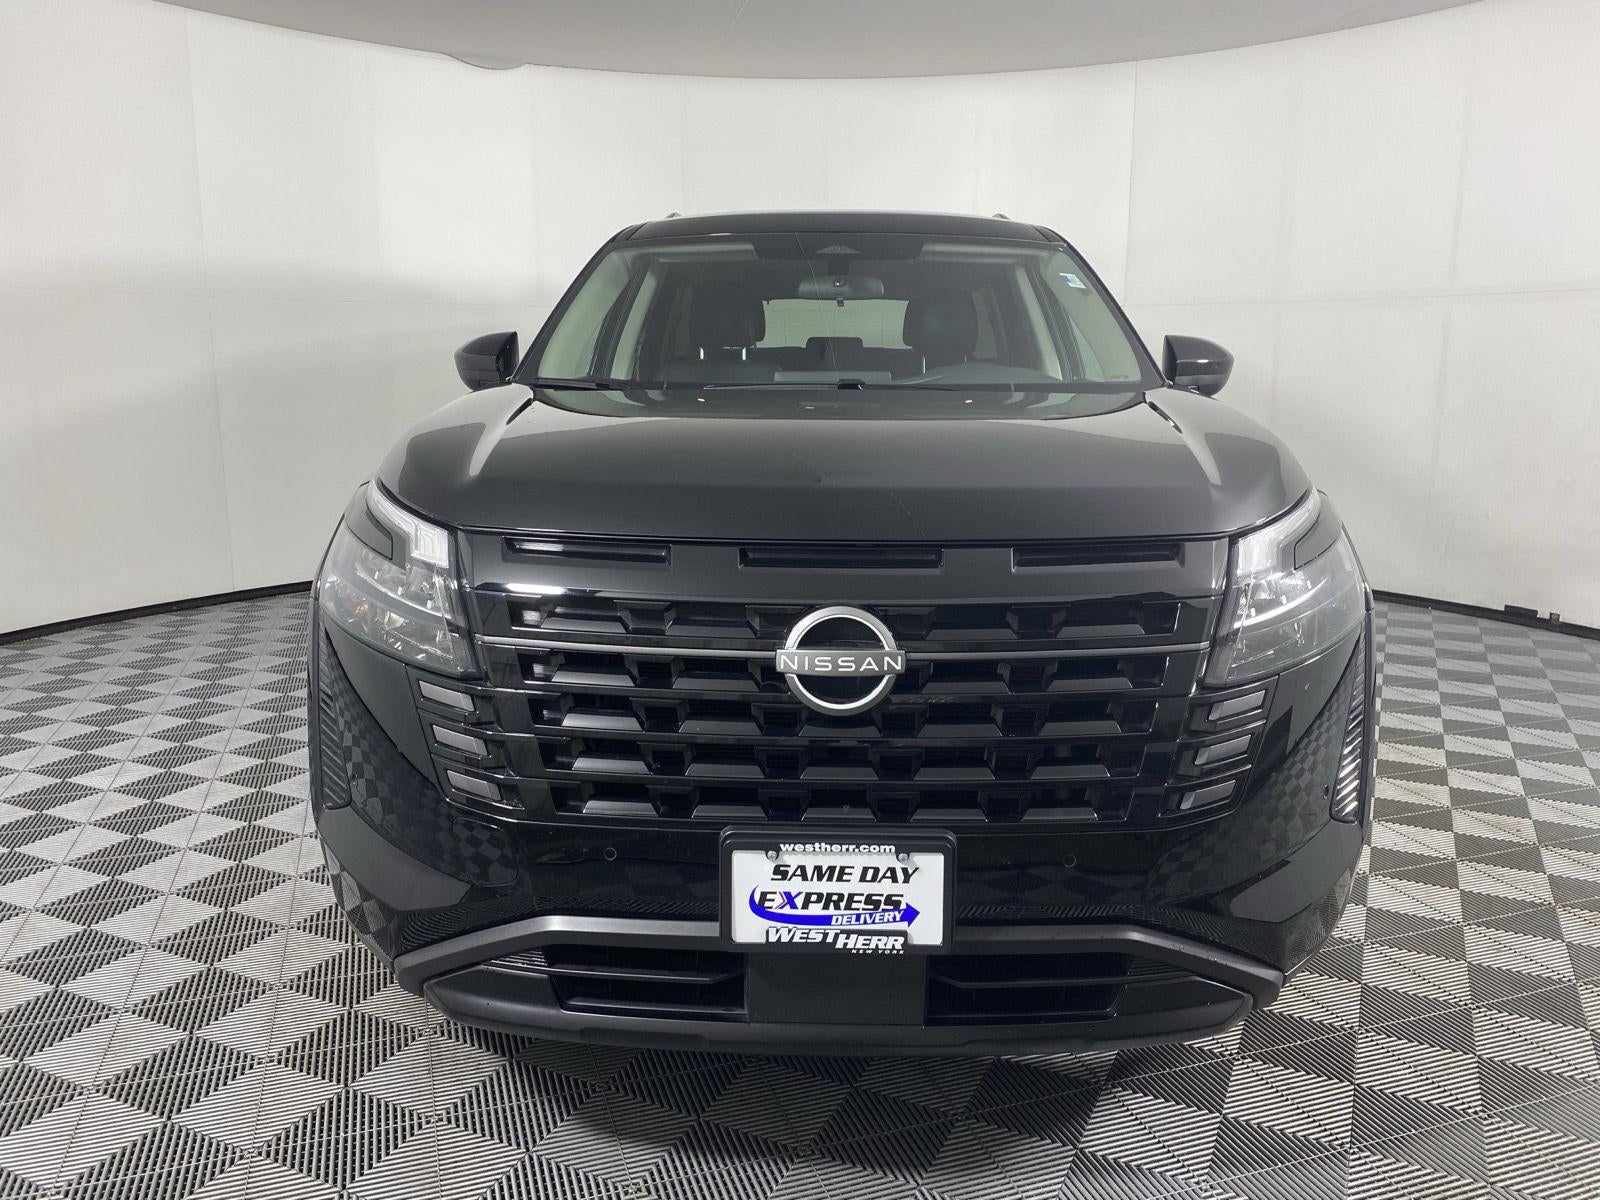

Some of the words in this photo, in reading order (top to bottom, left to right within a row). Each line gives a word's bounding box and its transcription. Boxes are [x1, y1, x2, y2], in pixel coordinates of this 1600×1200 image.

[779, 654, 902, 672] NISSAN
[780, 842, 896, 853] westherr.com
[771, 864, 855, 882] SAME
[858, 866, 920, 884] DAY
[758, 891, 904, 911] EXPRESS
[831, 911, 904, 926] DELIVERY
